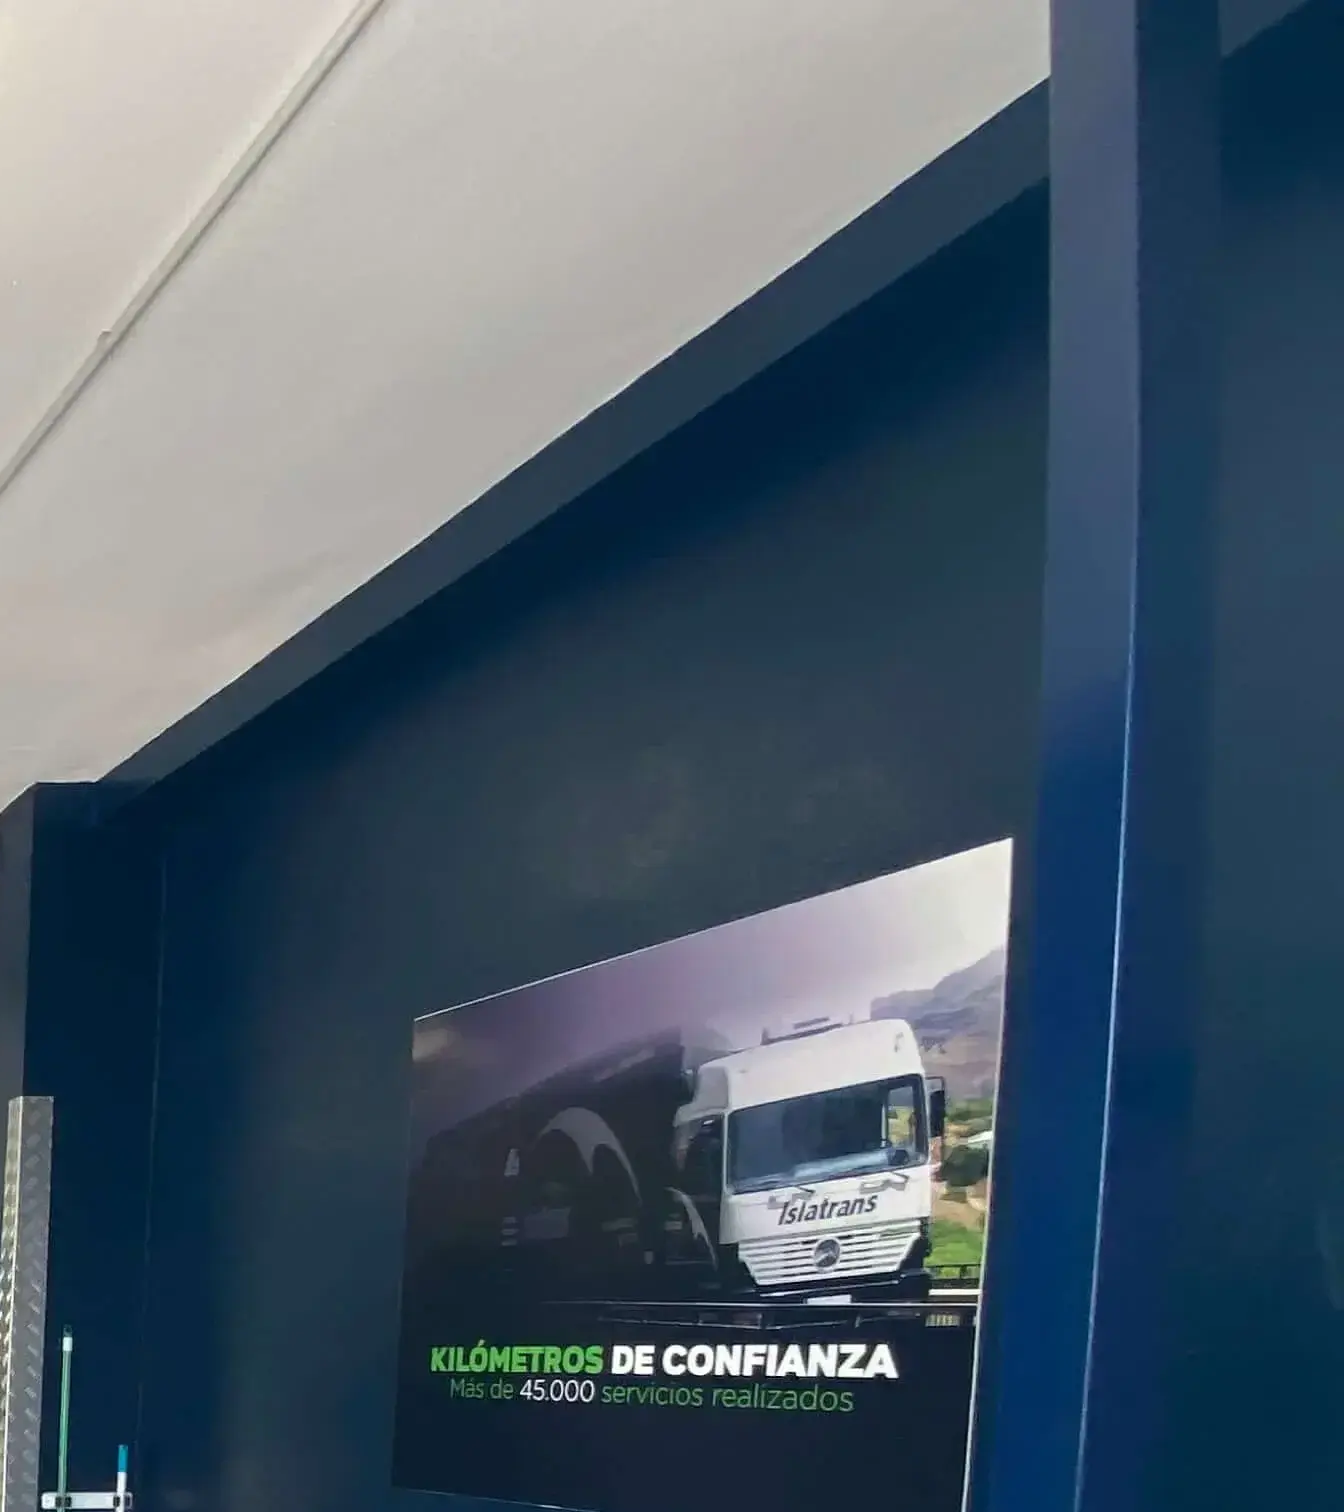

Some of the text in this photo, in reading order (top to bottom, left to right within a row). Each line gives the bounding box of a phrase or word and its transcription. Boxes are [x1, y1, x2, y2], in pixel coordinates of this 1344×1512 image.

[777, 1195, 878, 1226] Islatrans
[430, 1339, 899, 1379] KILÓMETROS DE CONFIANZA
[449, 1378, 854, 1412] Más de 45.000 servicios realizados
